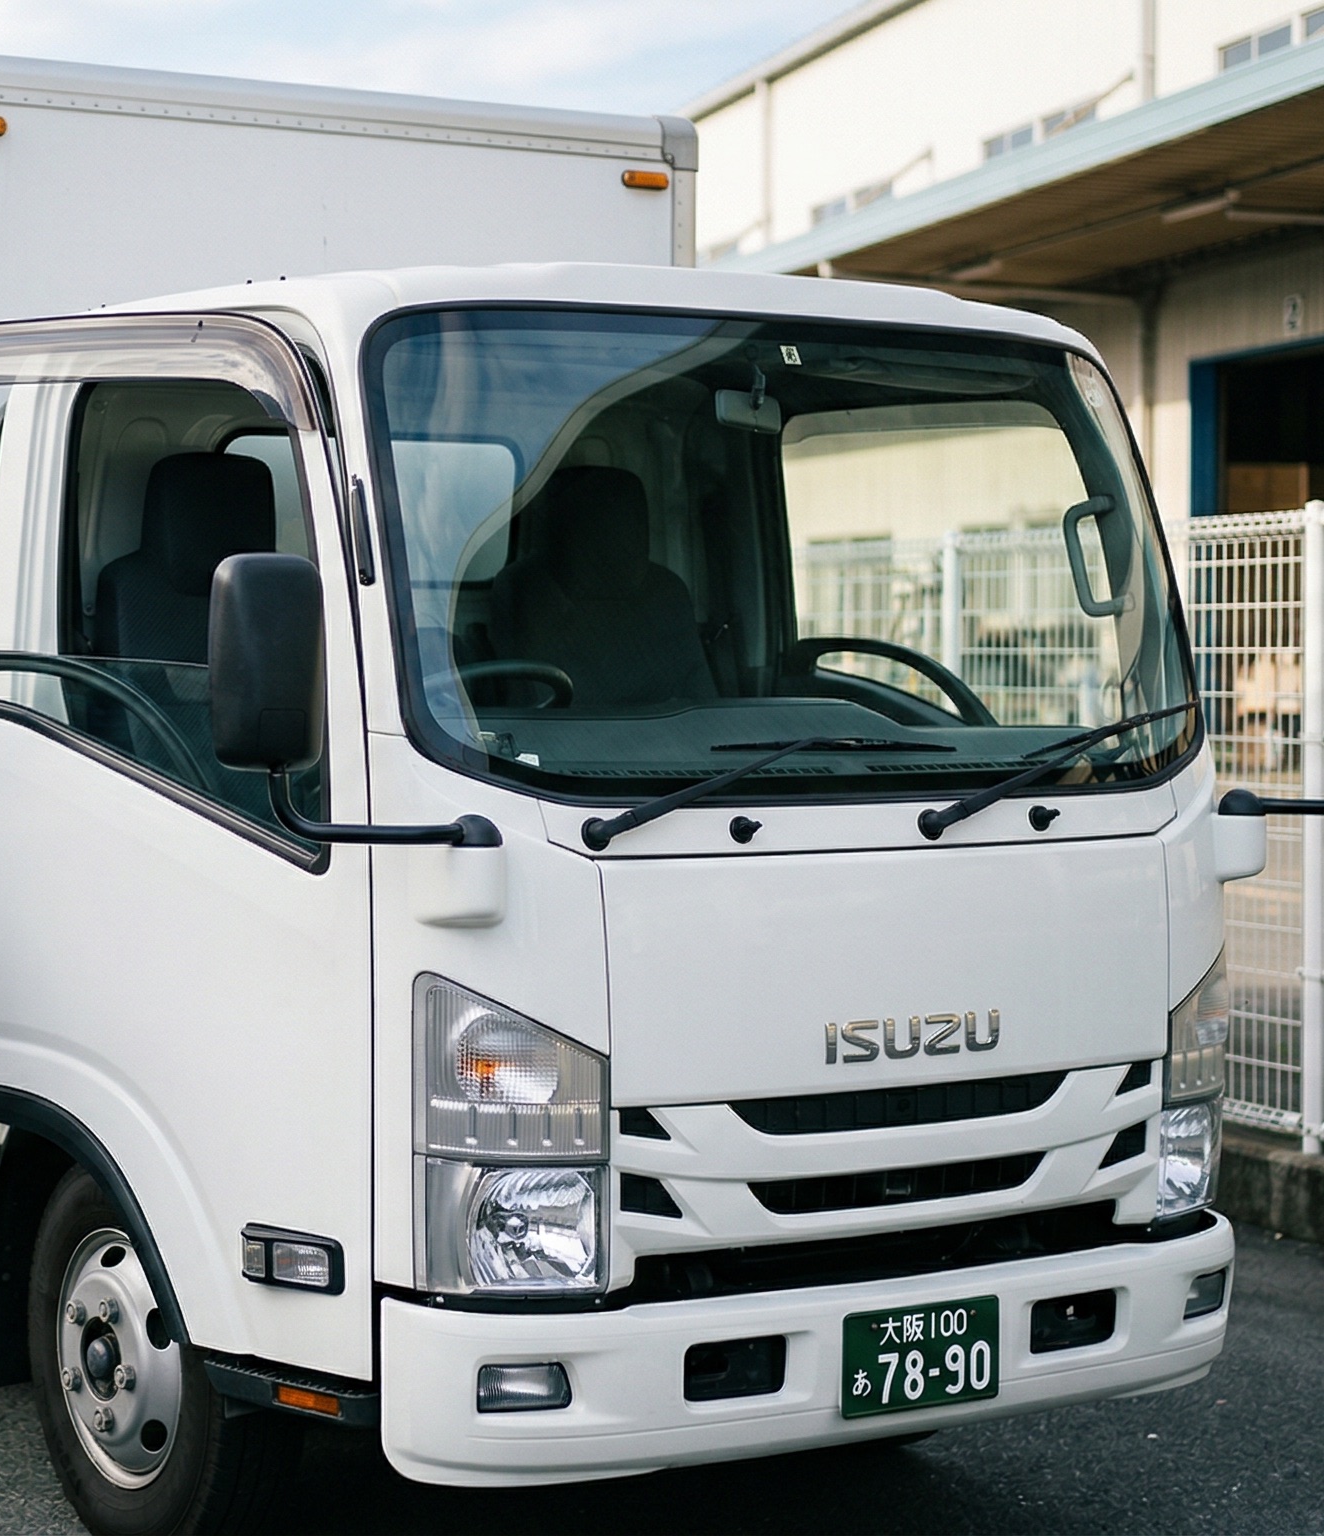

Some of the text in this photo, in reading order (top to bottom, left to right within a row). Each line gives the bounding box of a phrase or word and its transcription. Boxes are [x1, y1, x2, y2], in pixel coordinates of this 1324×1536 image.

[824, 1008, 1000, 1064] ISUZU
[852, 1340, 991, 1404] あ 78-90
